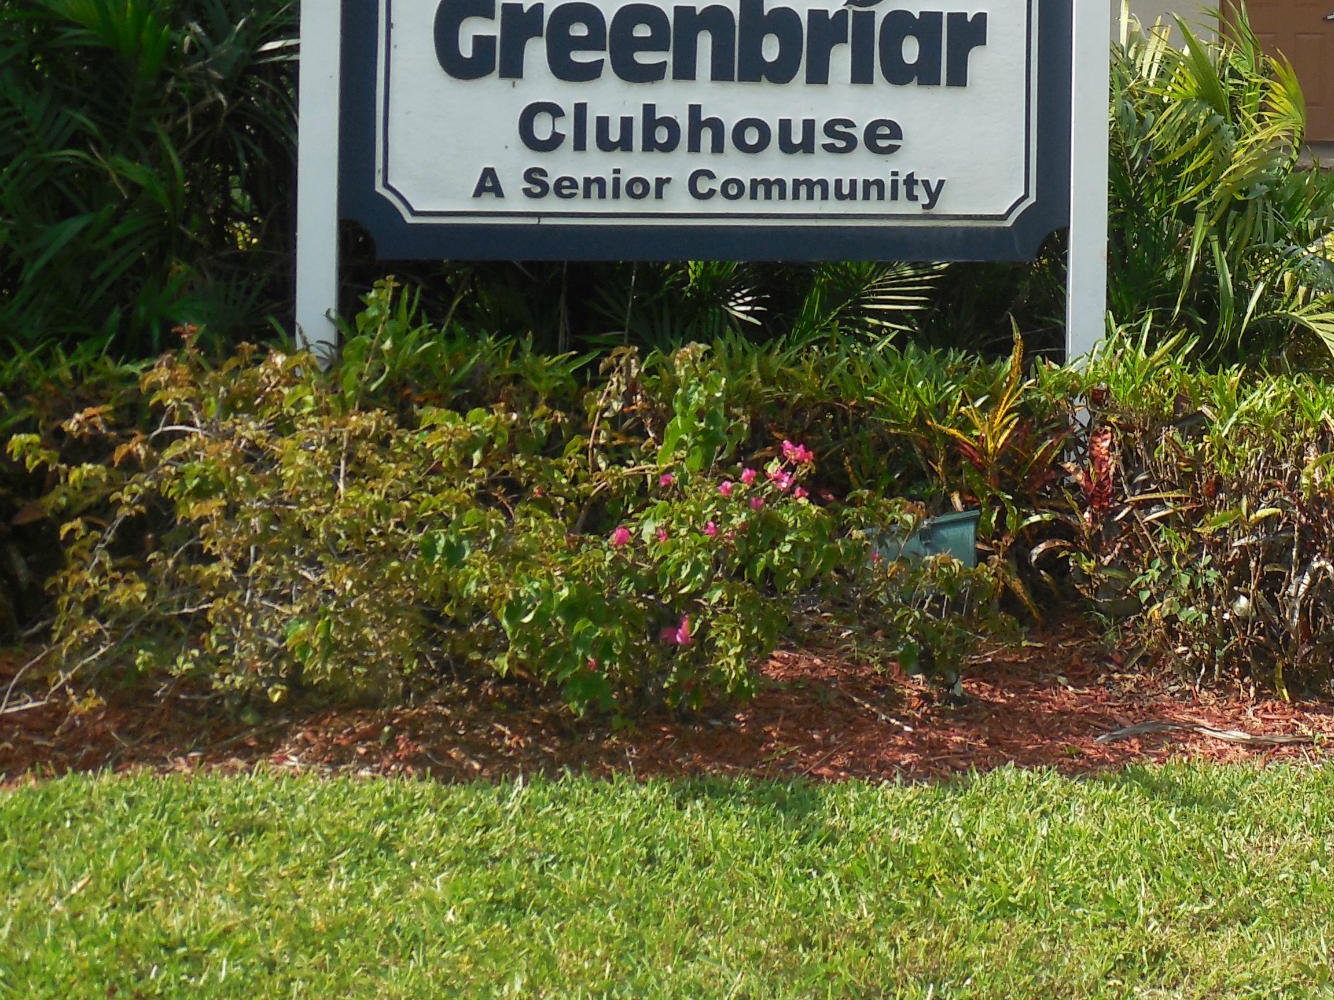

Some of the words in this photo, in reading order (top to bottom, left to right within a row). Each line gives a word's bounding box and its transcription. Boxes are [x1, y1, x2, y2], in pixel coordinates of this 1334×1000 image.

[518, 101, 904, 156] Clubhouse
[471, 167, 505, 199] A
[521, 166, 673, 201] Senior
[687, 167, 946, 210] Community
